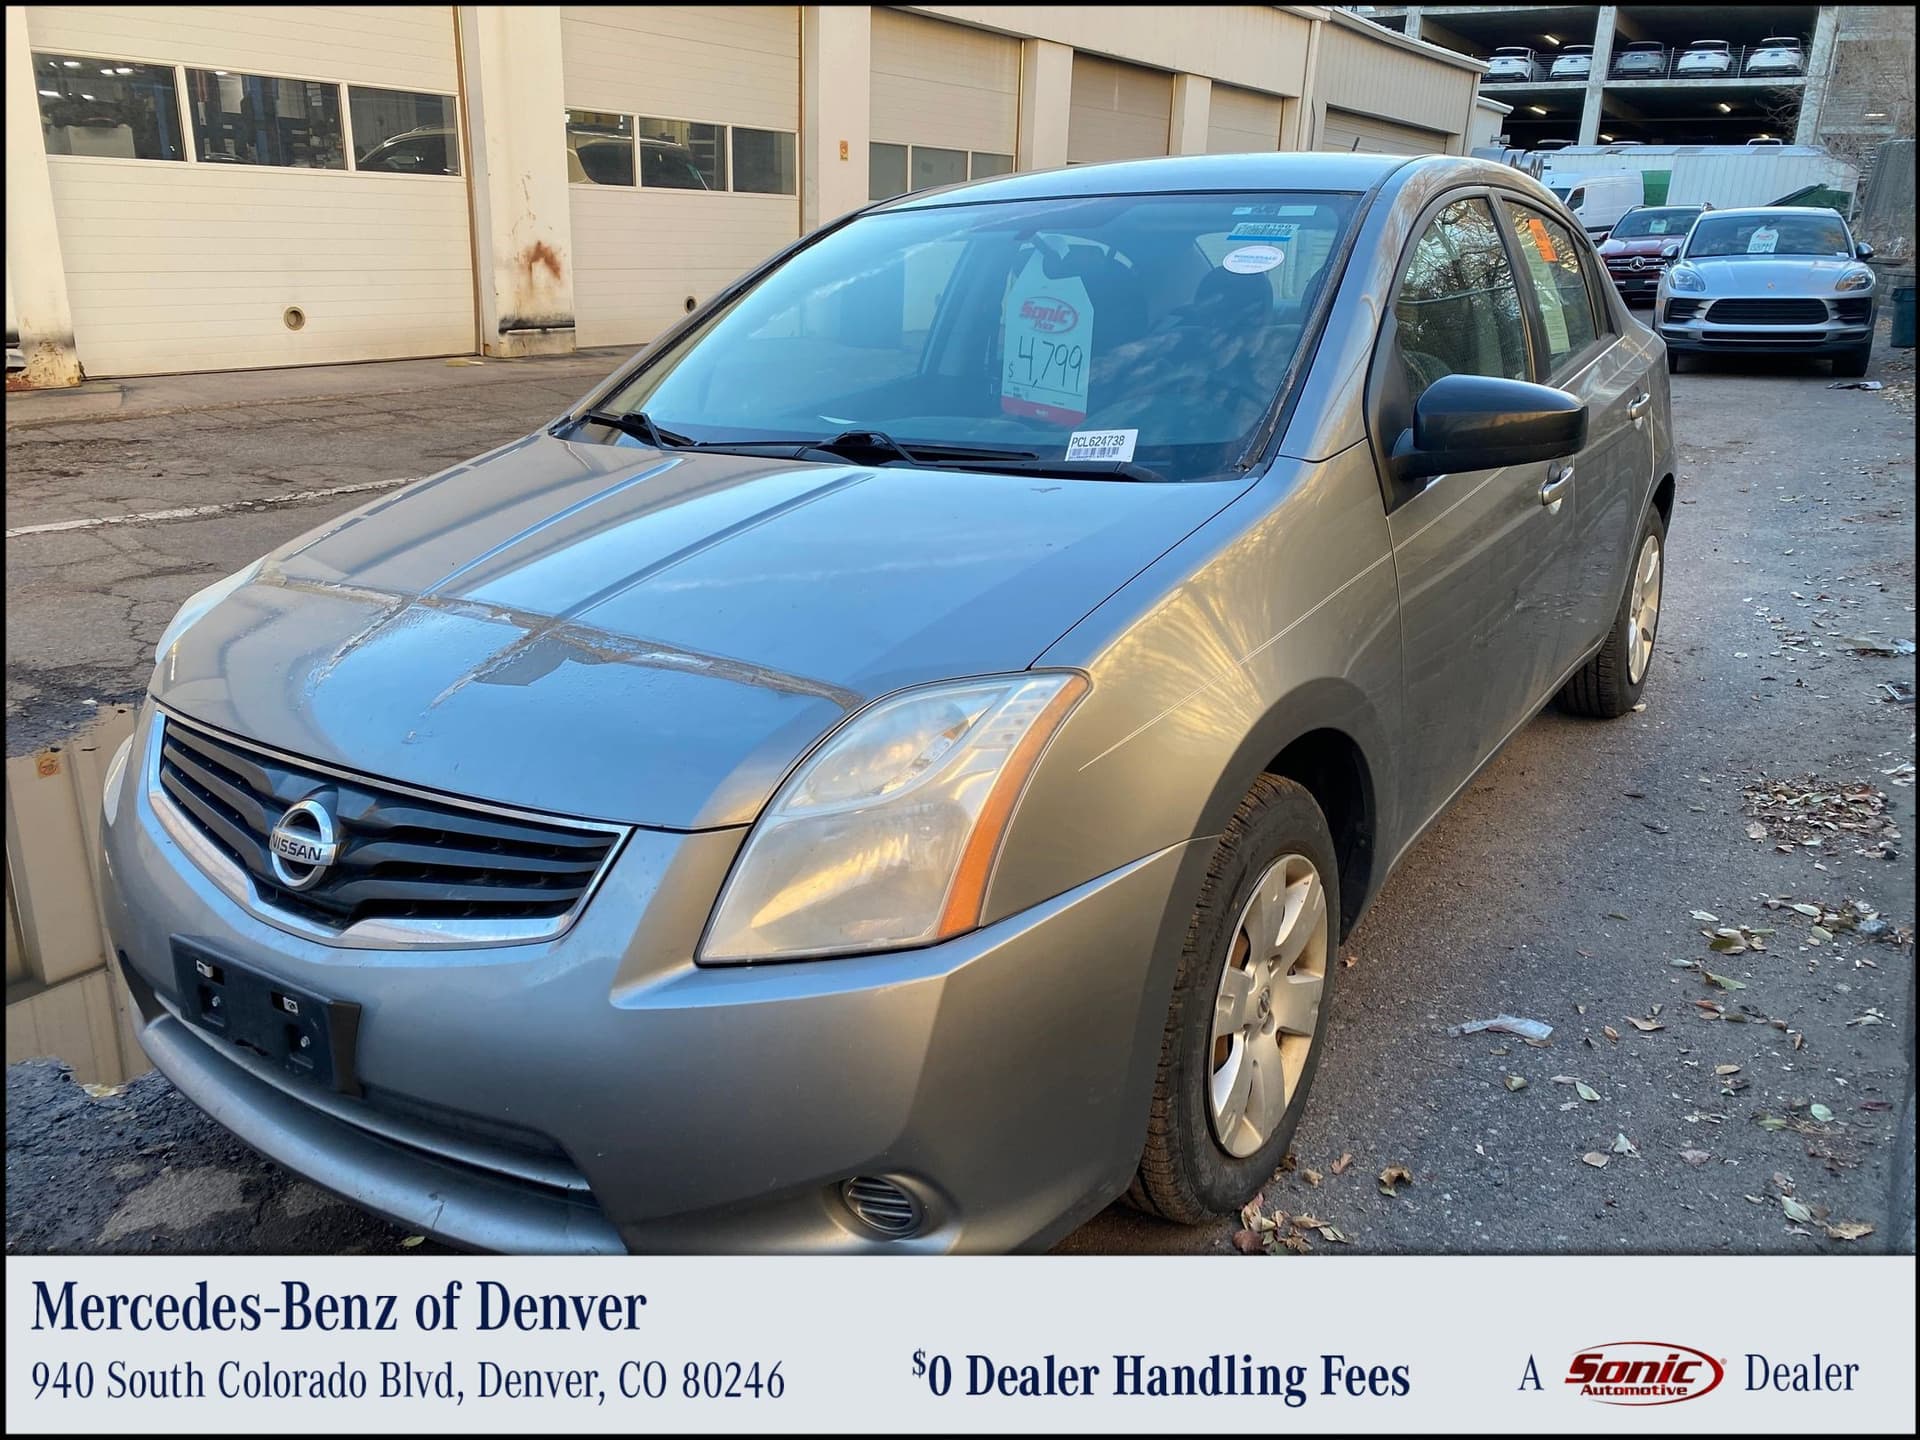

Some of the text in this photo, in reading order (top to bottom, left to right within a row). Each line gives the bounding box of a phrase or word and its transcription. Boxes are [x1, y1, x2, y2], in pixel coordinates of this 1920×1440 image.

[1020, 300, 1069, 324] Sonic
[1071, 434, 1126, 448] PCL624738
[270, 833, 323, 861] NISSAN
